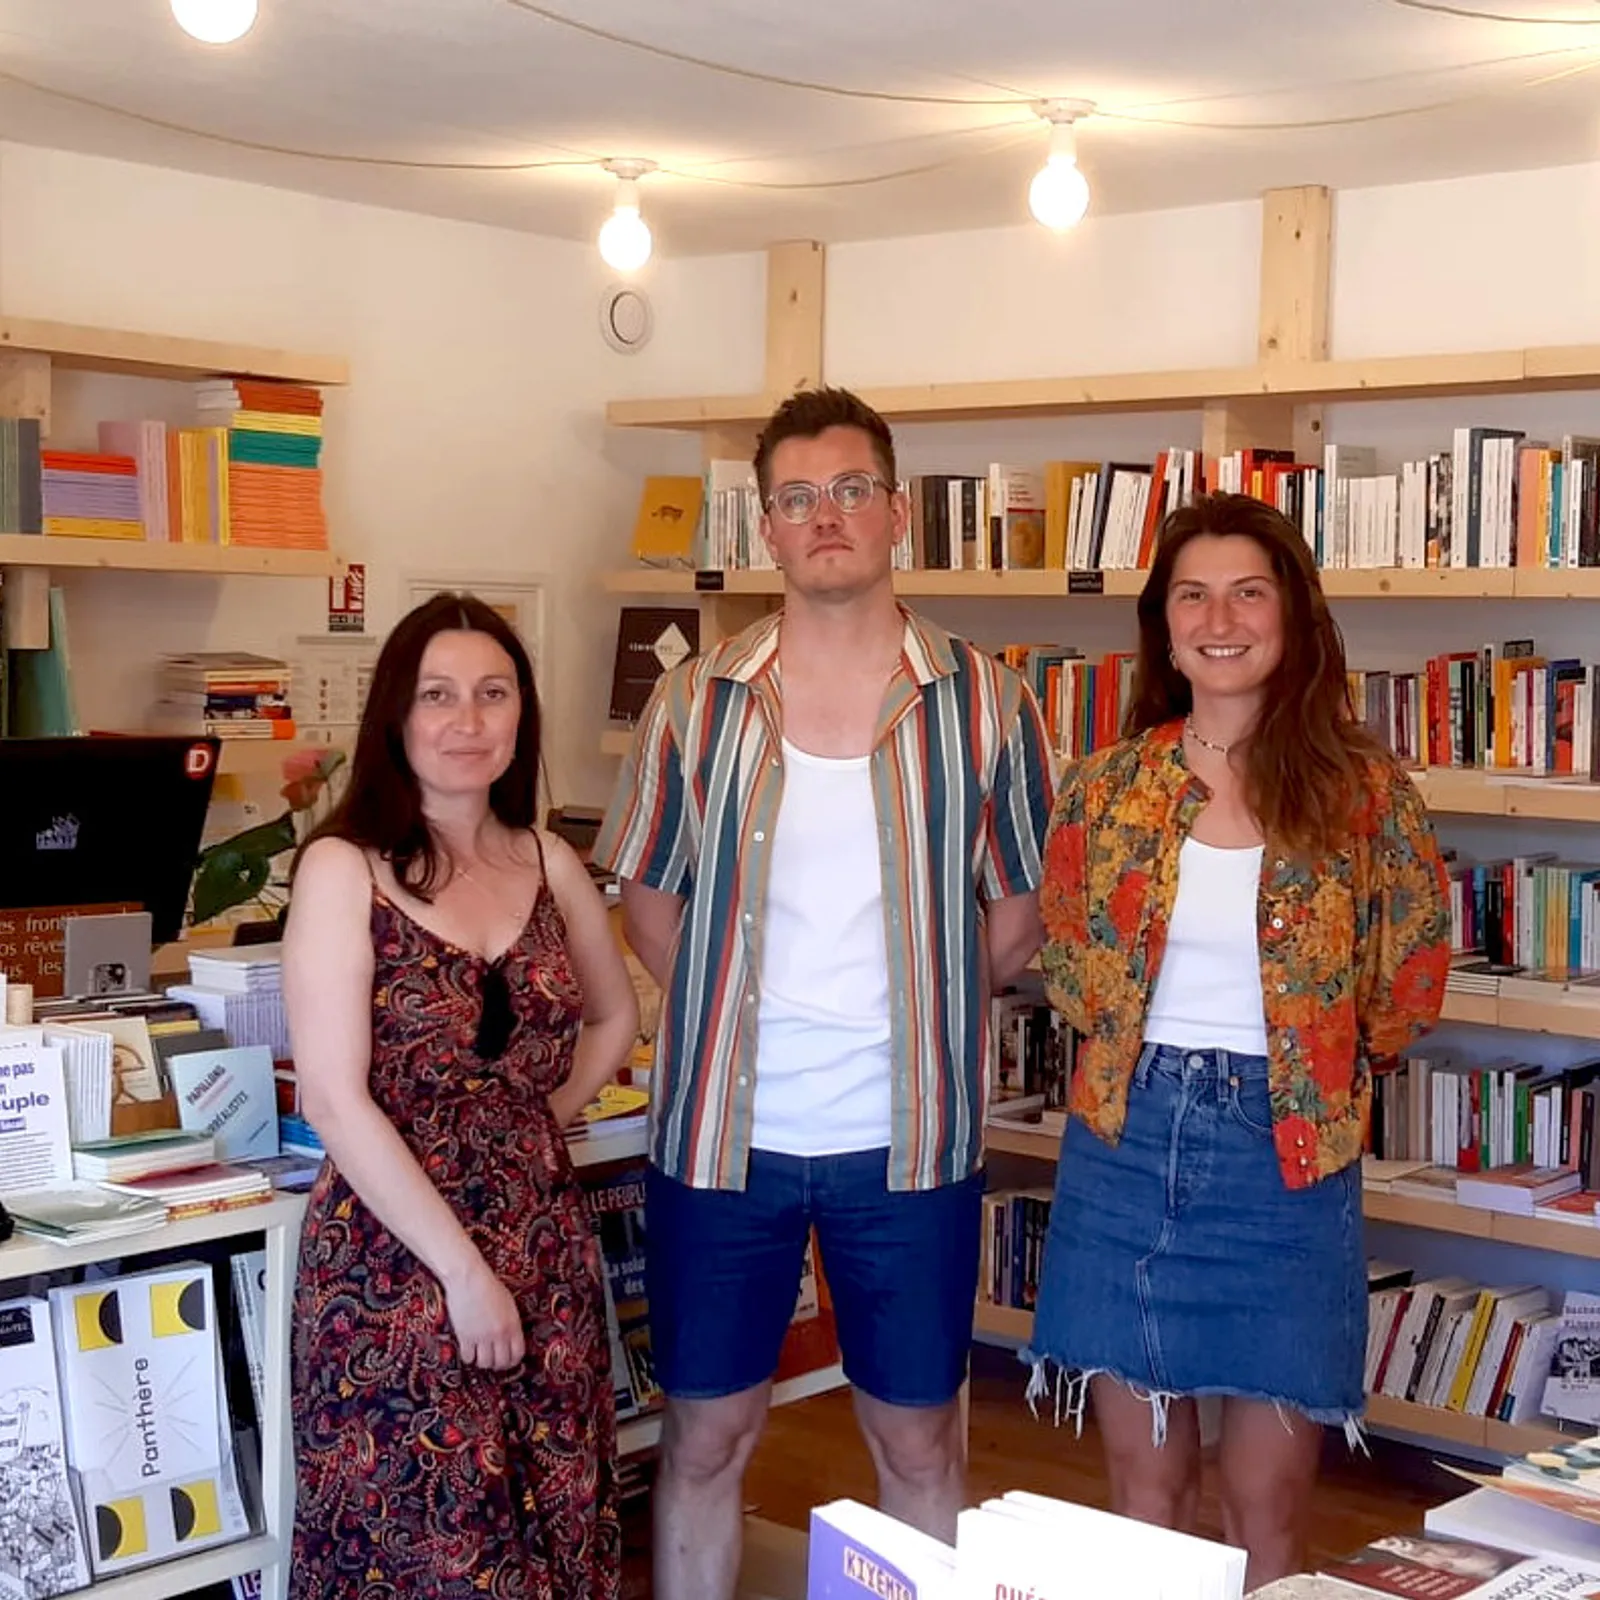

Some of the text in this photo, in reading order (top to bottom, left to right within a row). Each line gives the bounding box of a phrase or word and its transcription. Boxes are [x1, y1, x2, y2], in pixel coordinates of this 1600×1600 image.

[187, 750, 210, 772] D
[23, 935, 65, 955] rêve
[39, 955, 63, 976] les
[12, 1062, 35, 1080] pas
[186, 1064, 226, 1105] PAPILLONS
[1, 1091, 50, 1113] uple
[132, 1357, 161, 1477] Panthère
